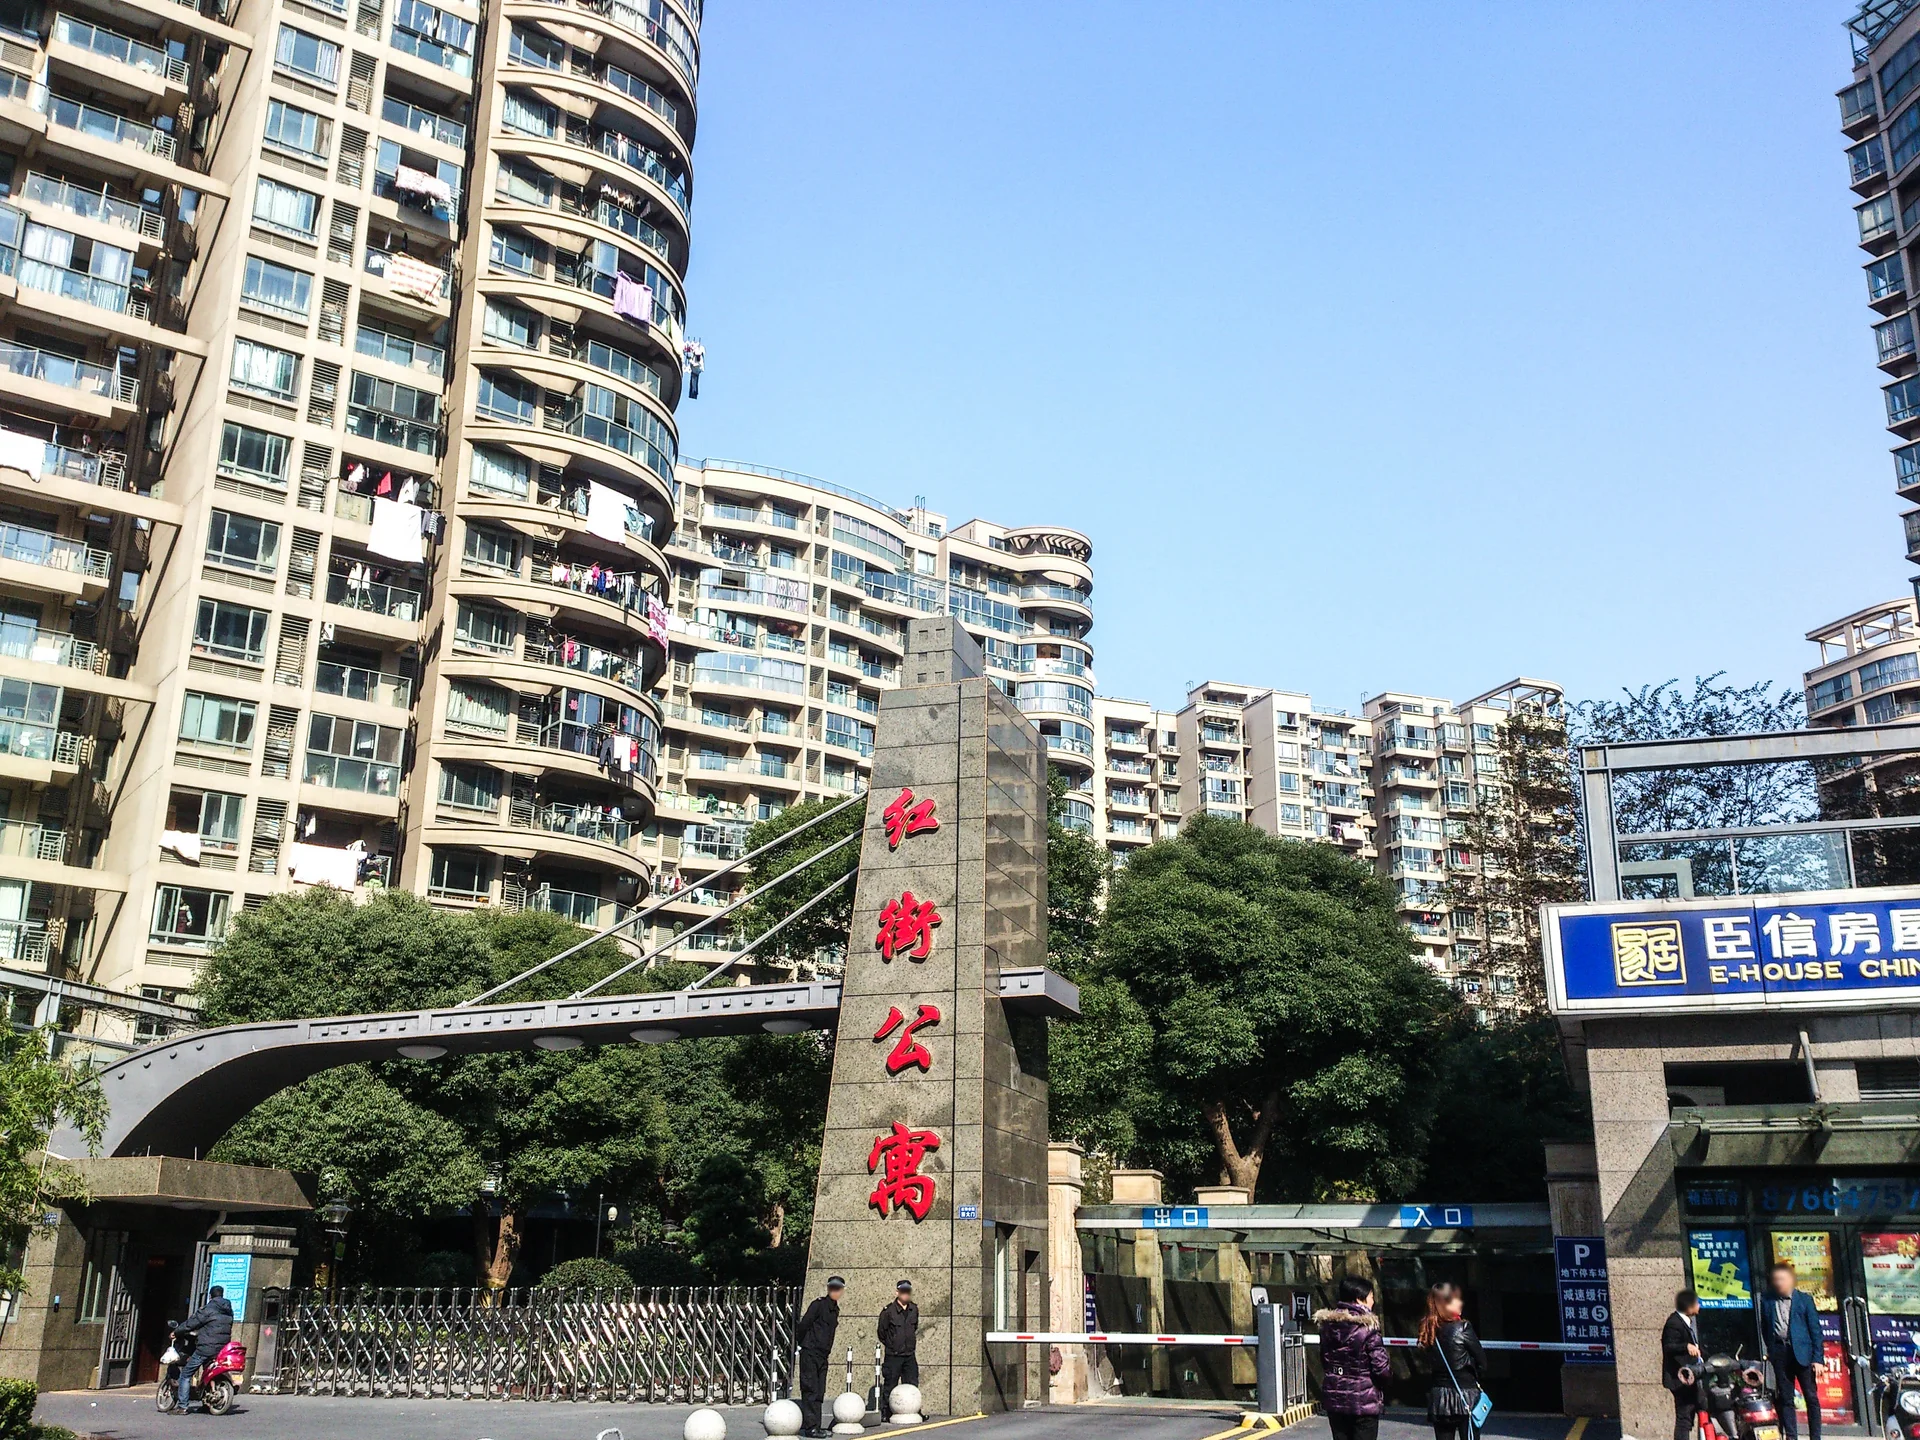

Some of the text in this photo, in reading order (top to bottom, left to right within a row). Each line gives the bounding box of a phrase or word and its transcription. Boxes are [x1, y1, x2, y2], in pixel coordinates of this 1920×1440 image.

[1709, 960, 1843, 984] E-HOUSE
[868, 786, 941, 1220] 红街公寓
[1153, 1208, 1199, 1226] 出口
[1413, 1207, 1462, 1226] 入口
[1574, 1244, 1590, 1266] P
[1560, 1268, 1607, 1278] 地下停车场
[1563, 1288, 1608, 1301] 减速缓行
[1566, 1325, 1611, 1338] 禁止跟车
